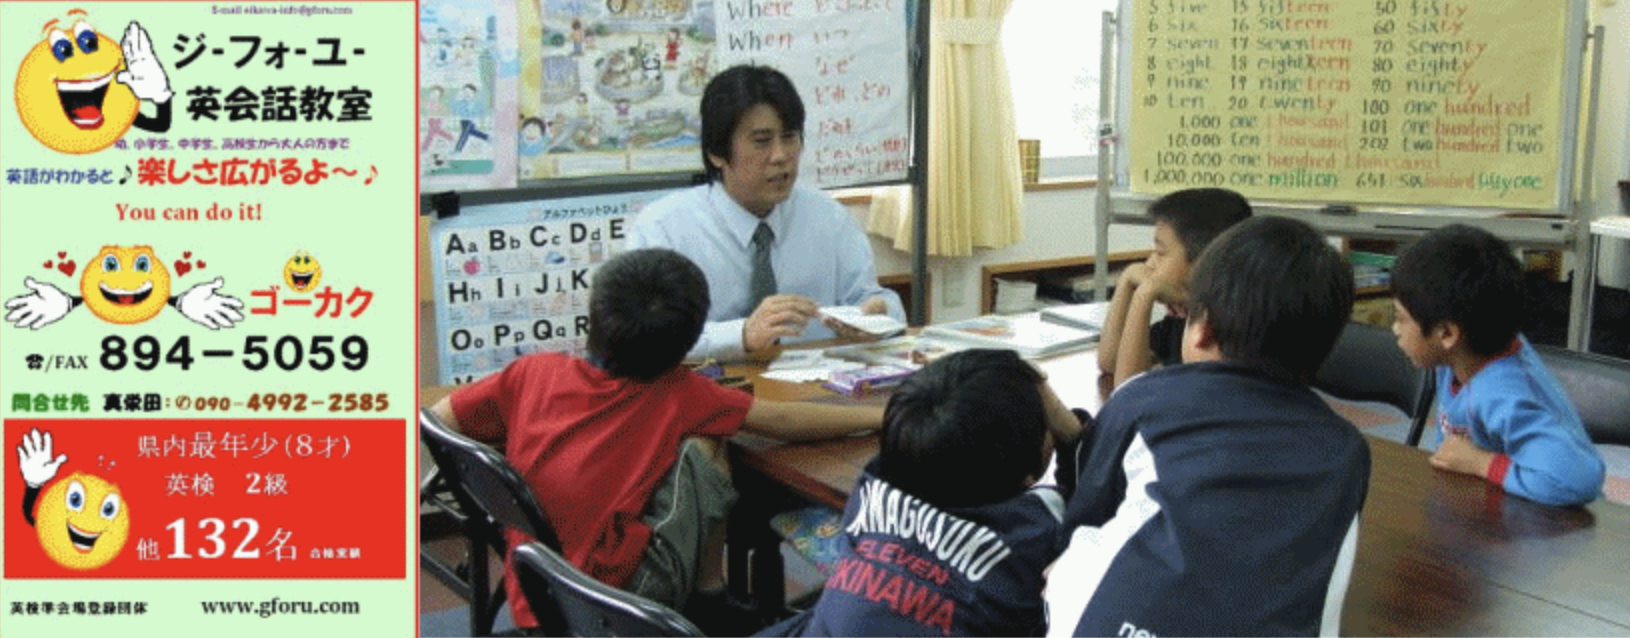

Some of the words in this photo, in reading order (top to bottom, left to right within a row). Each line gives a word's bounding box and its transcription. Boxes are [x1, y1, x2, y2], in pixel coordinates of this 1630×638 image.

[1375, 0, 1397, 16] 50
[1149, 16, 1158, 32] 6
[1166, 16, 1198, 31] six
[1231, 17, 1249, 31] 16
[1373, 19, 1395, 35] 60
[729, 29, 793, 51] When
[1147, 37, 1157, 50] 7
[1230, 36, 1249, 50] 17
[1373, 39, 1393, 54] 70
[1147, 55, 1156, 71] 8
[1166, 54, 1211, 75] eight
[1231, 55, 1247, 71] 18
[1372, 58, 1393, 73] 80
[1147, 73, 1155, 88] 9
[1167, 76, 1209, 89] nine
[1230, 74, 1247, 90] 19
[1371, 78, 1391, 93] 90
[1143, 95, 1158, 108] 10
[1229, 96, 1248, 109] 20
[1362, 99, 1389, 115] 100
[1403, 100, 1437, 115] one
[1229, 115, 1258, 129] one
[1361, 119, 1387, 135] 101
[1401, 119, 1431, 135] one
[1507, 122, 1543, 137] one
[1231, 133, 1260, 147] ten
[1403, 137, 1433, 152] two
[1507, 139, 1543, 154] two
[1229, 153, 1261, 166] one
[1229, 172, 1263, 186] one
[609, 218, 625, 240] E
[572, 268, 589, 290] K
[574, 316, 590, 336] R
